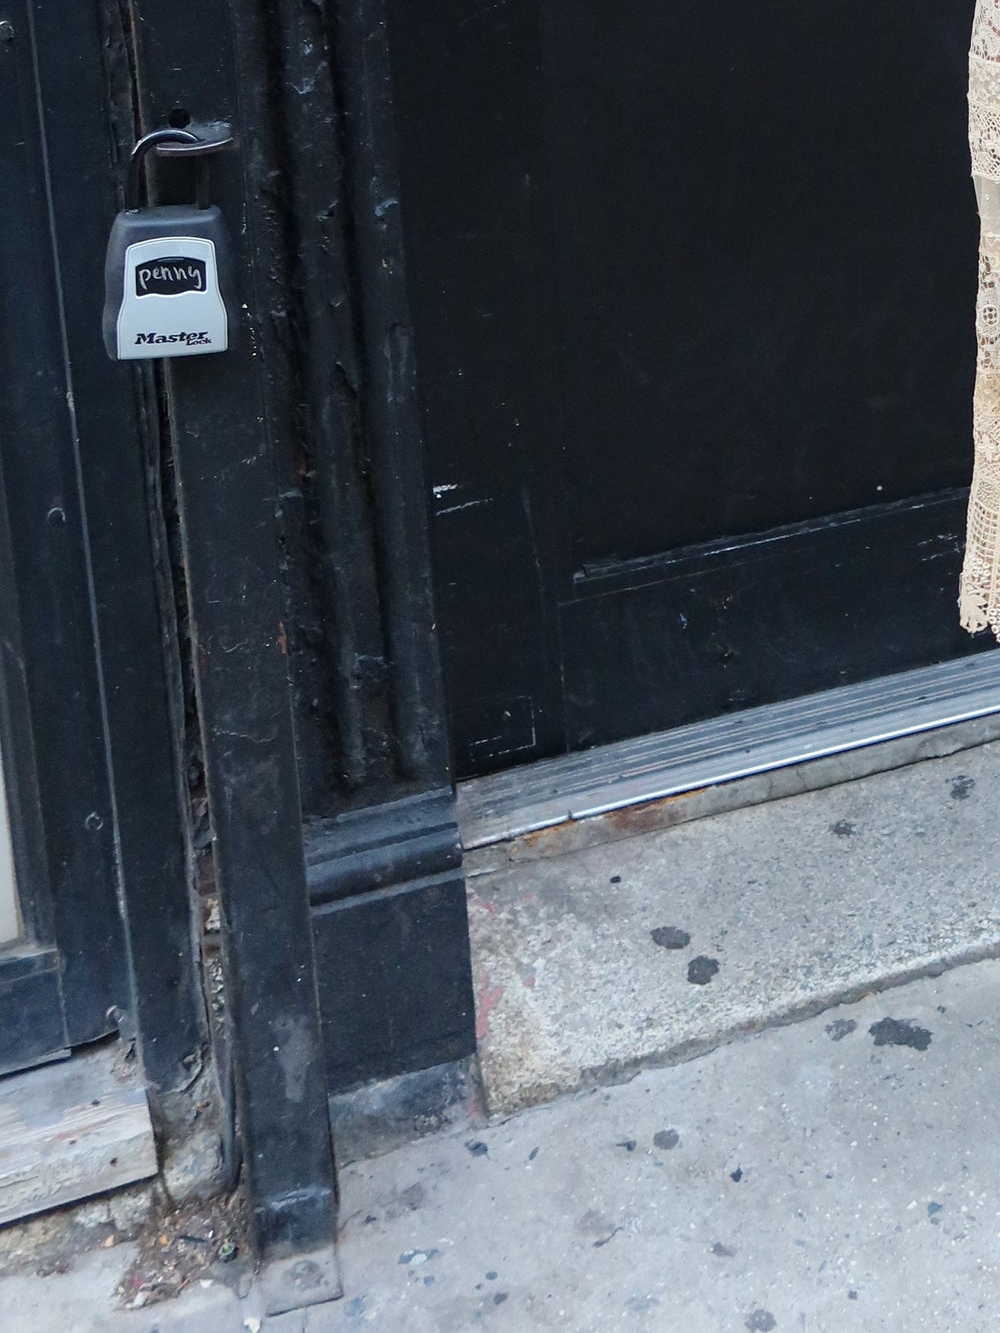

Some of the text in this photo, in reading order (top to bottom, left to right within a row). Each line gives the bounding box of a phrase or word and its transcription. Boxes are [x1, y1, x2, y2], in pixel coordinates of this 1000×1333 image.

[138, 266, 202, 290] penny
[134, 331, 212, 347] Master Lock
